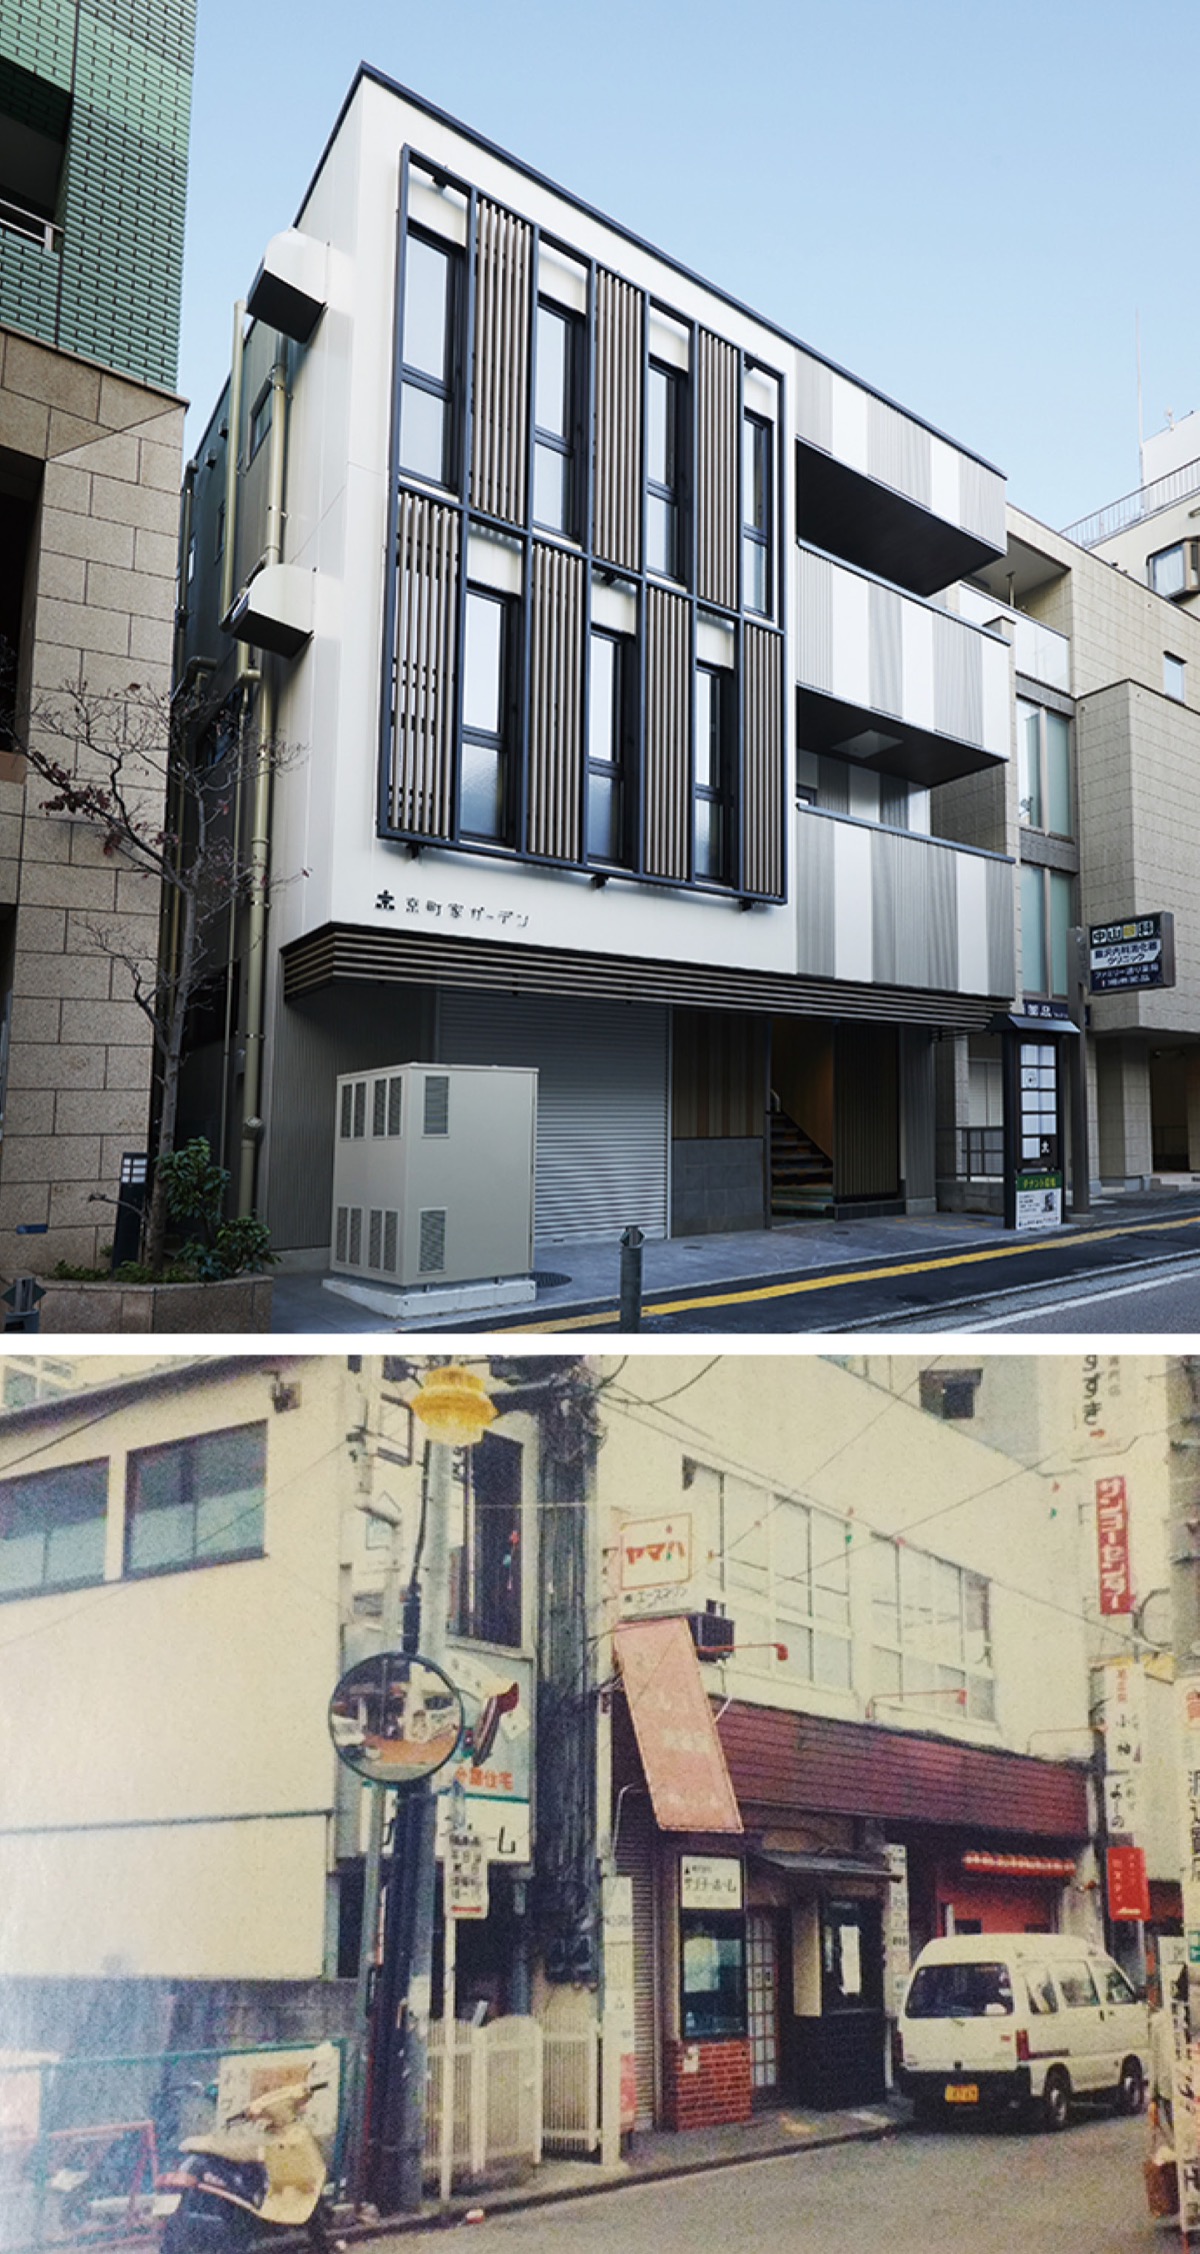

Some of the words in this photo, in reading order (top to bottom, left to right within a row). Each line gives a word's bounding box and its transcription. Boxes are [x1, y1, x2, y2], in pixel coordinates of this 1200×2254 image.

[406, 897, 529, 927] 京町家ガーデン
[625, 1540, 687, 1566] ヤマハ
